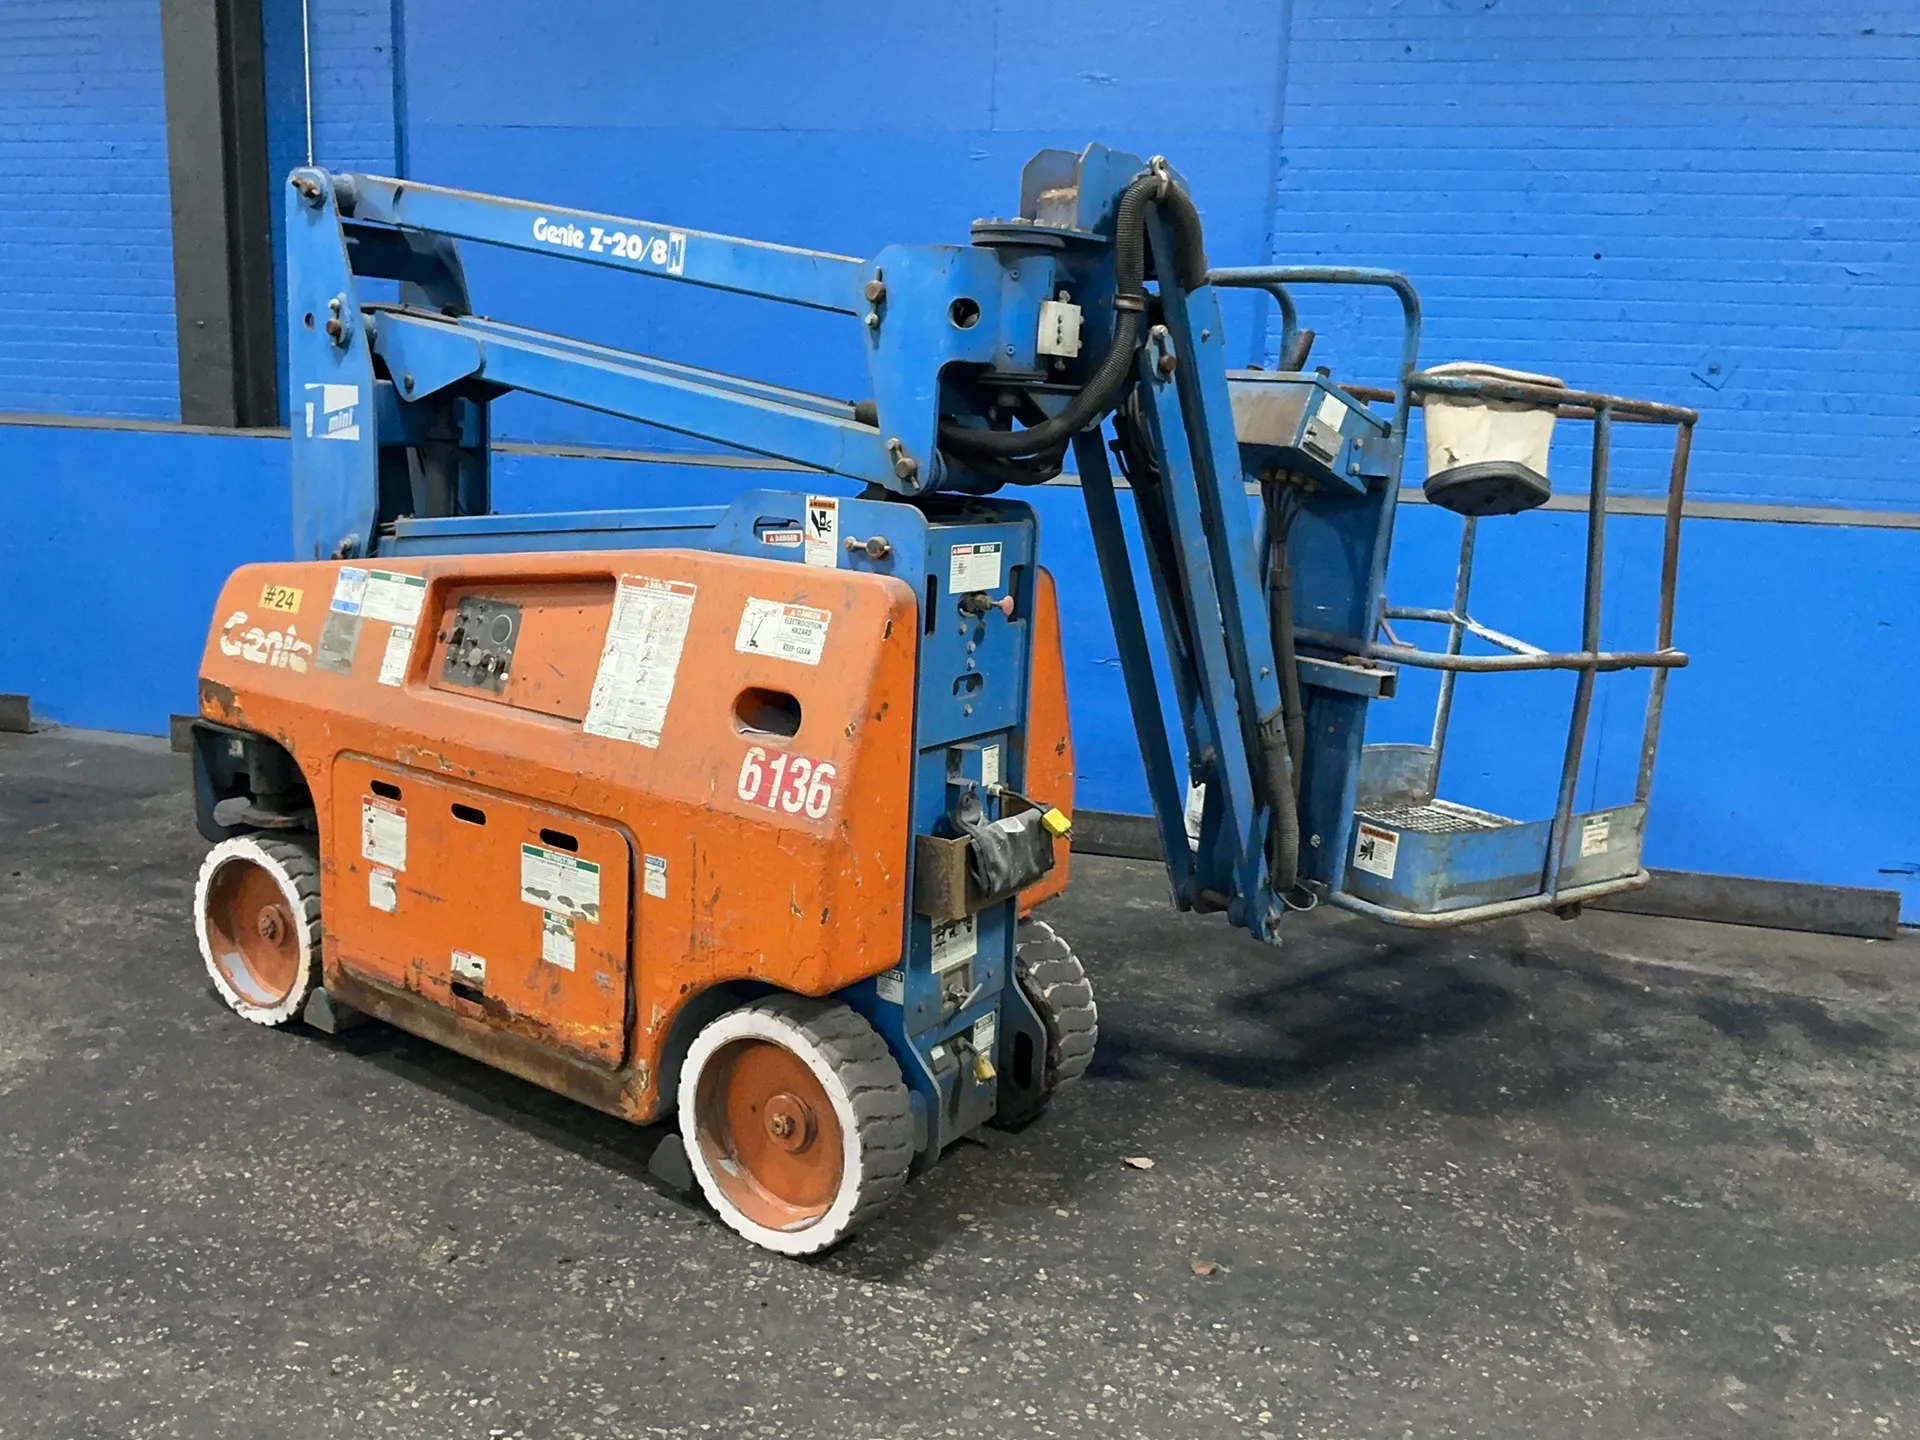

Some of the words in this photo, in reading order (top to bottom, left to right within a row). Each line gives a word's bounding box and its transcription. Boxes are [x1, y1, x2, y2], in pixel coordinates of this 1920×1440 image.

[533, 216, 585, 249] Genie
[774, 533, 799, 542] DANGER
[263, 585, 296, 610] #24
[797, 609, 822, 621] DANGER
[784, 616, 823, 630] ELECTROCUTION
[791, 627, 813, 637] HAZARD
[782, 642, 795, 653] KEEP
[796, 646, 812, 656] CLEAR
[738, 746, 836, 819] 6136
[646, 857, 665, 868] NOTICE
